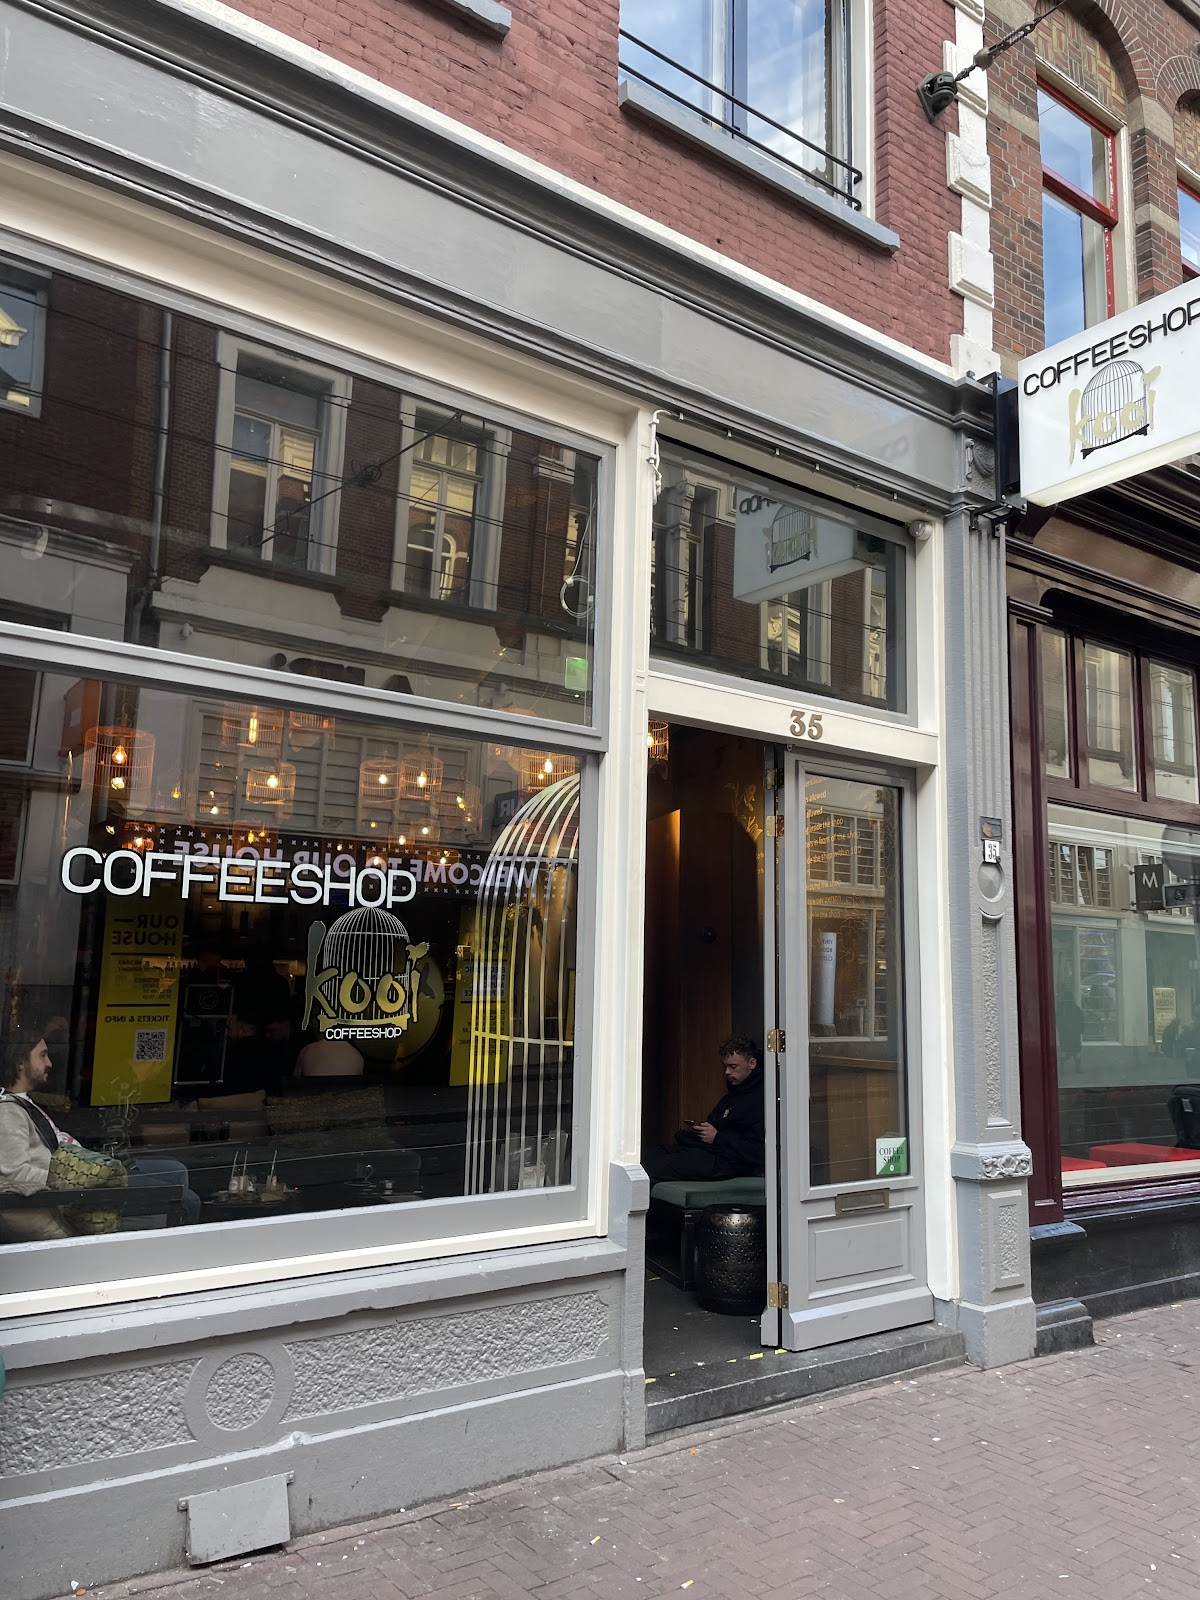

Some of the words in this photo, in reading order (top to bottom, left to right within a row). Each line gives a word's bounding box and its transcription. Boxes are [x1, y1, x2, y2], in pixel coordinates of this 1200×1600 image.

[1023, 297, 1200, 397] COFFEESHOP
[790, 709, 823, 740] 35
[988, 843, 997, 860] 35
[61, 847, 417, 909] COFFEESHOP
[302, 921, 428, 1030] kooi
[325, 1027, 402, 1040] COFFEESHOP
[878, 1147, 905, 1156] COFFEE
[883, 1156, 901, 1164] SHOP
